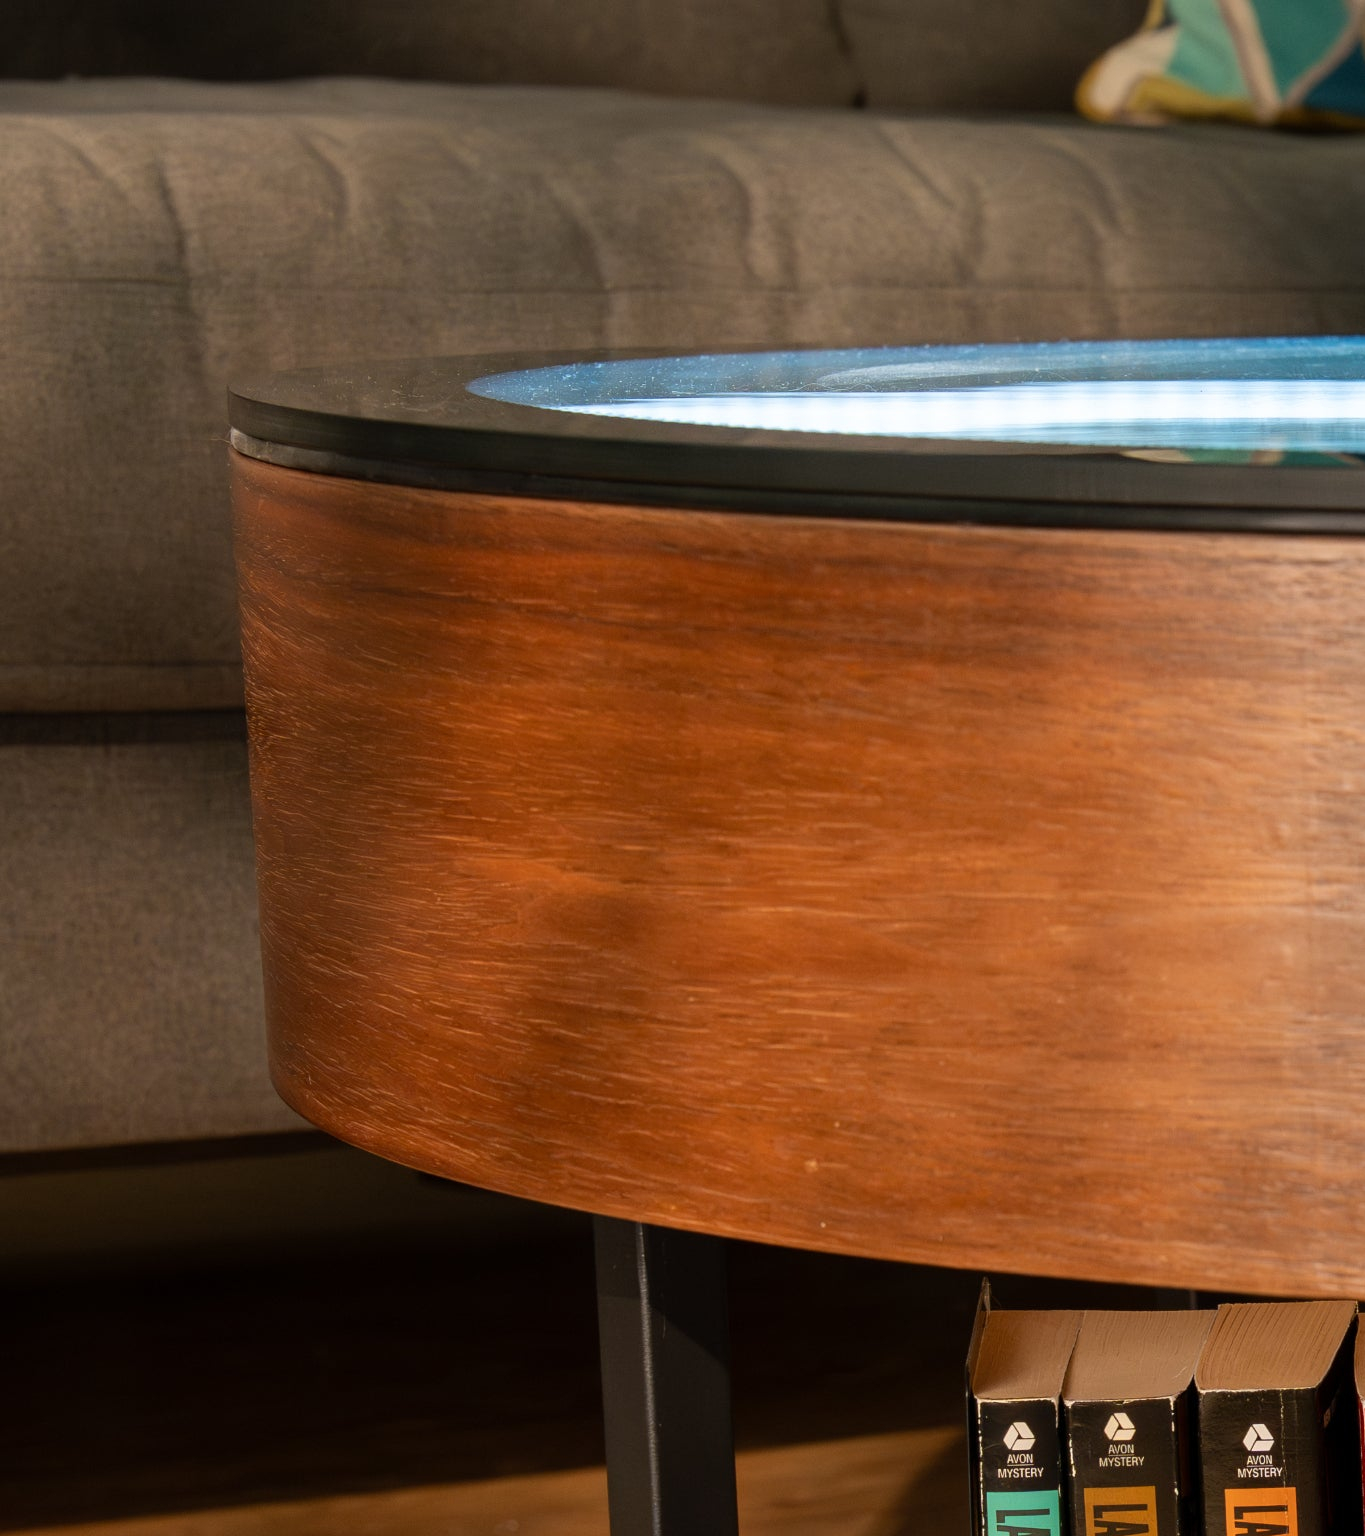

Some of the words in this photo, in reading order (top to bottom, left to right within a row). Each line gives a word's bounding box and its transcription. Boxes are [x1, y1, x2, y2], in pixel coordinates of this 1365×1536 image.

[1108, 1444, 1134, 1455] AVON
[1007, 1454, 1033, 1465] AVON
[1098, 1456, 1144, 1468] MYSTERY
[1246, 1455, 1272, 1466] AVON
[998, 1467, 1044, 1479] MYSTERY
[1237, 1467, 1282, 1479] MYSTERY
